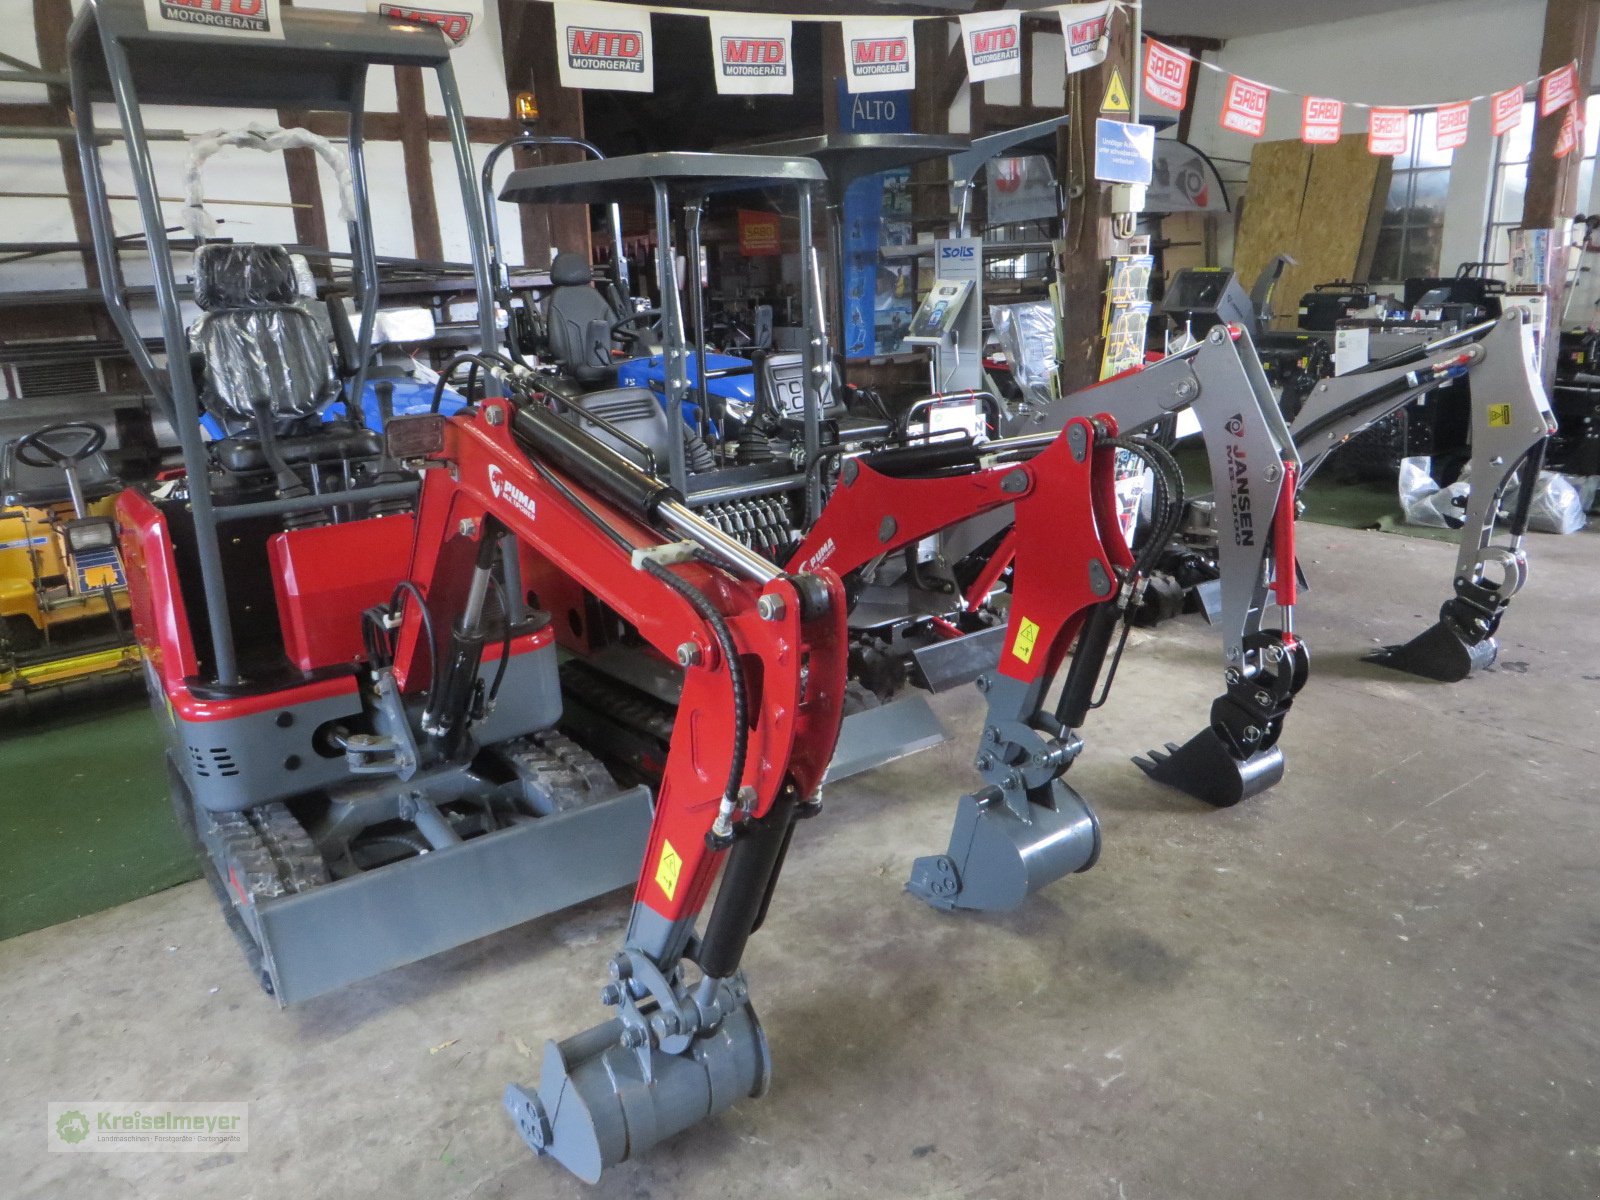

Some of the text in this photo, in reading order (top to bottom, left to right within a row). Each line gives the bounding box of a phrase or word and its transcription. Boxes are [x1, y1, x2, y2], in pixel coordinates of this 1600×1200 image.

[572, 30, 640, 58] MTD
[726, 40, 783, 63] MTD
[856, 40, 906, 63] MTD
[975, 27, 1016, 53] MTD
[573, 58, 640, 71] MOTORGERÄTE
[726, 65, 784, 75] MOTORGERÄTE
[856, 63, 907, 75] MOTORGERÄTE
[1150, 51, 1183, 83] SABO
[851, 93, 896, 129] ALTO
[1232, 86, 1265, 112] SABO
[1309, 101, 1339, 119] SABO
[503, 480, 536, 514] PUMA
[1233, 445, 1254, 546] JANSEN
[810, 537, 834, 568] PUMA
